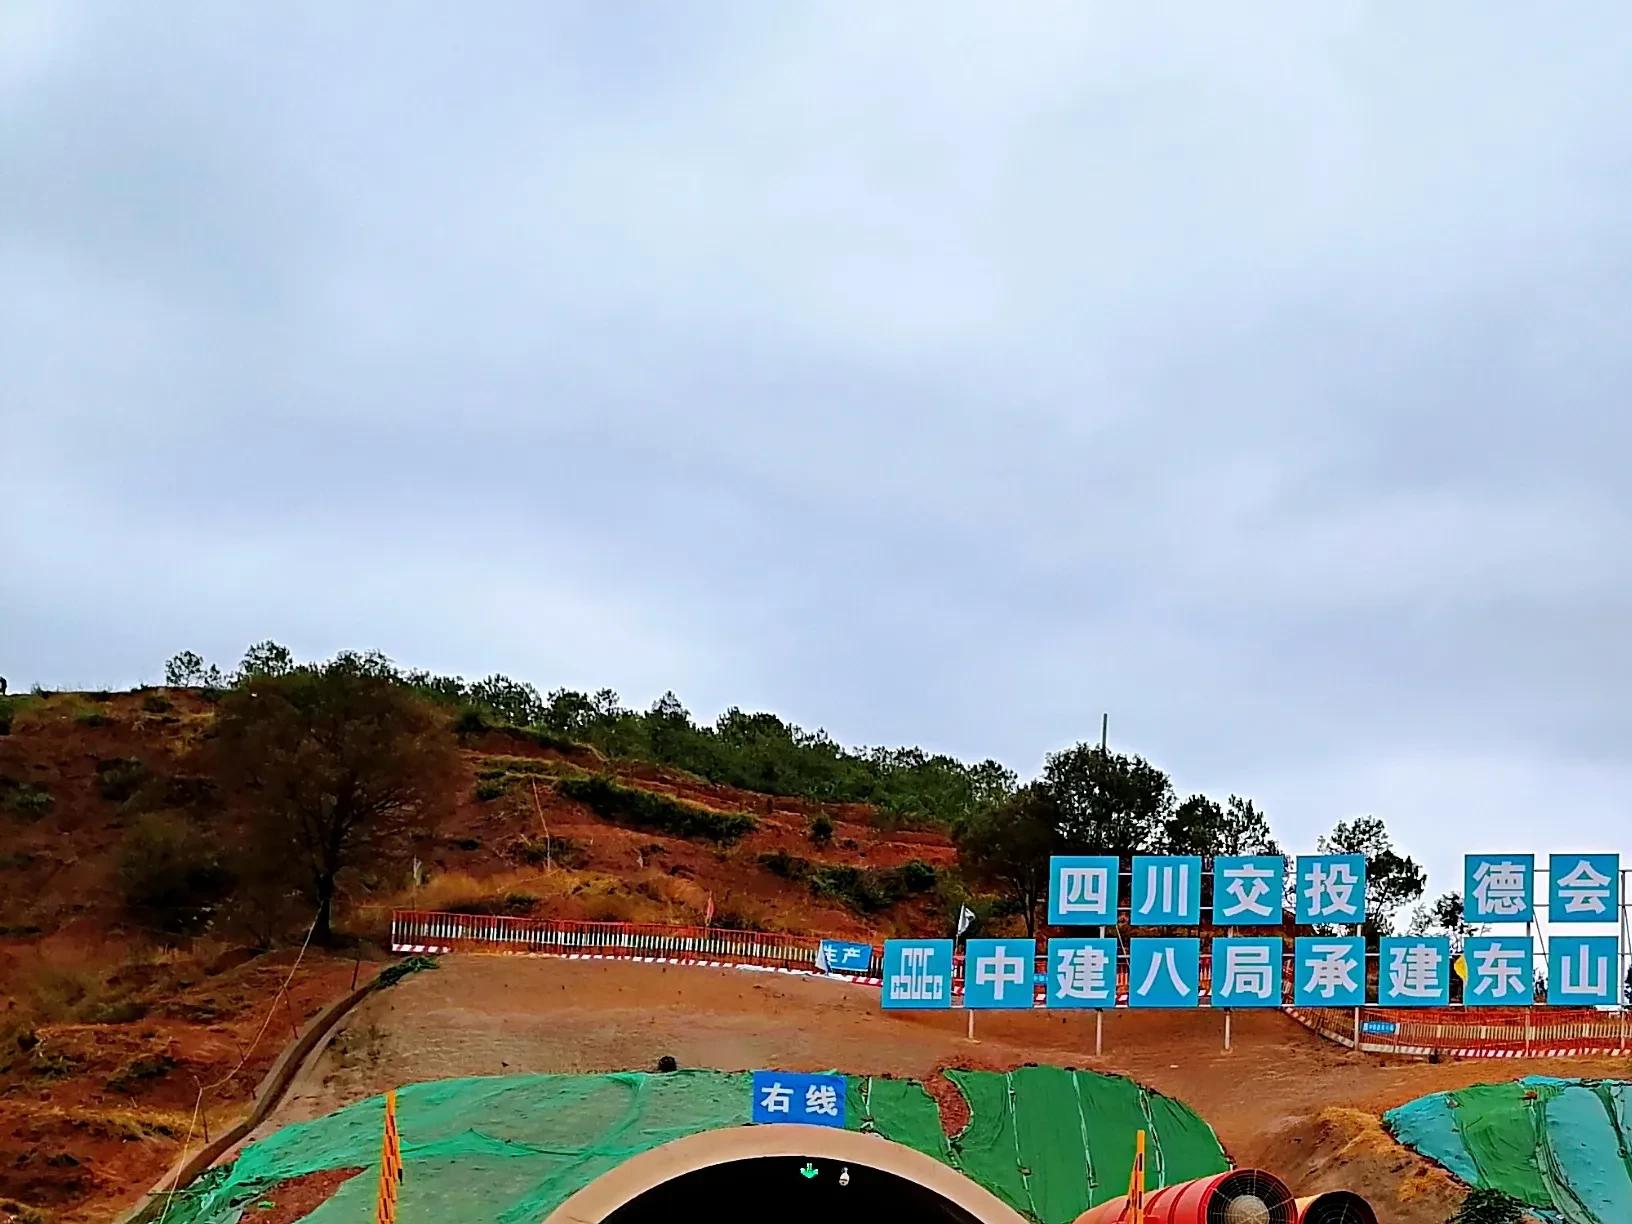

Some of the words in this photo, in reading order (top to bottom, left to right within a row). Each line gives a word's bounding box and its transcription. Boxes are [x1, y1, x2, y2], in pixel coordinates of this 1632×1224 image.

[1059, 862, 1358, 917] 四川交投
[760, 1081, 838, 1117] 右线
